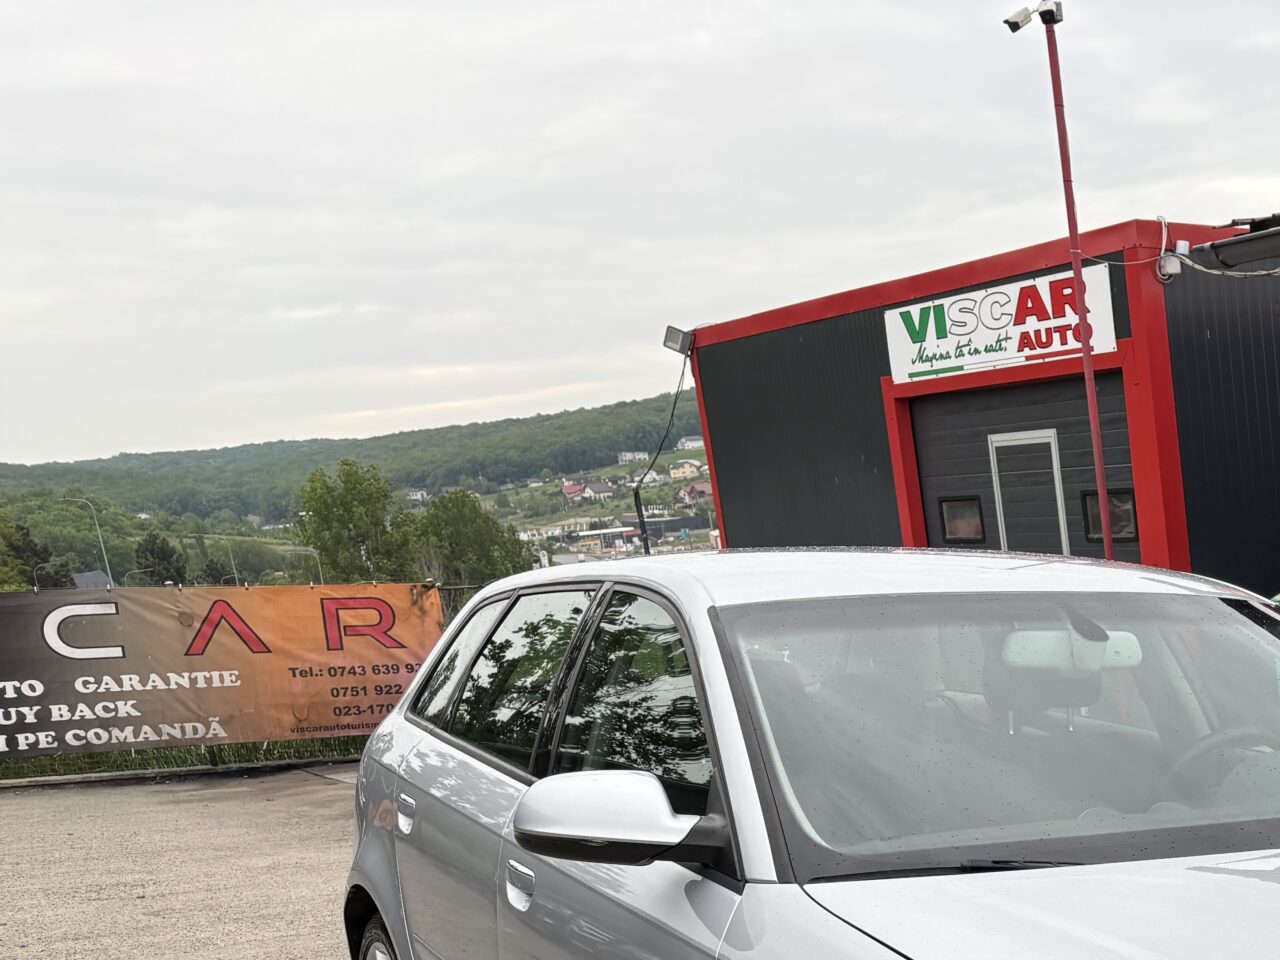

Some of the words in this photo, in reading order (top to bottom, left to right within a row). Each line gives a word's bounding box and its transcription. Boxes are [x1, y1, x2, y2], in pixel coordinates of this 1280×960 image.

[899, 276, 1091, 344] VISCAR
[1017, 322, 1094, 353] AUTO
[74, 670, 241, 693] GARANTIE
[288, 666, 324, 678] Tel.:
[327, 665, 367, 678] 0743
[371, 664, 400, 675] 639
[330, 686, 368, 698] 0751
[374, 684, 403, 695] 922
[49, 700, 141, 722] BACK
[15, 731, 58, 750] PE
